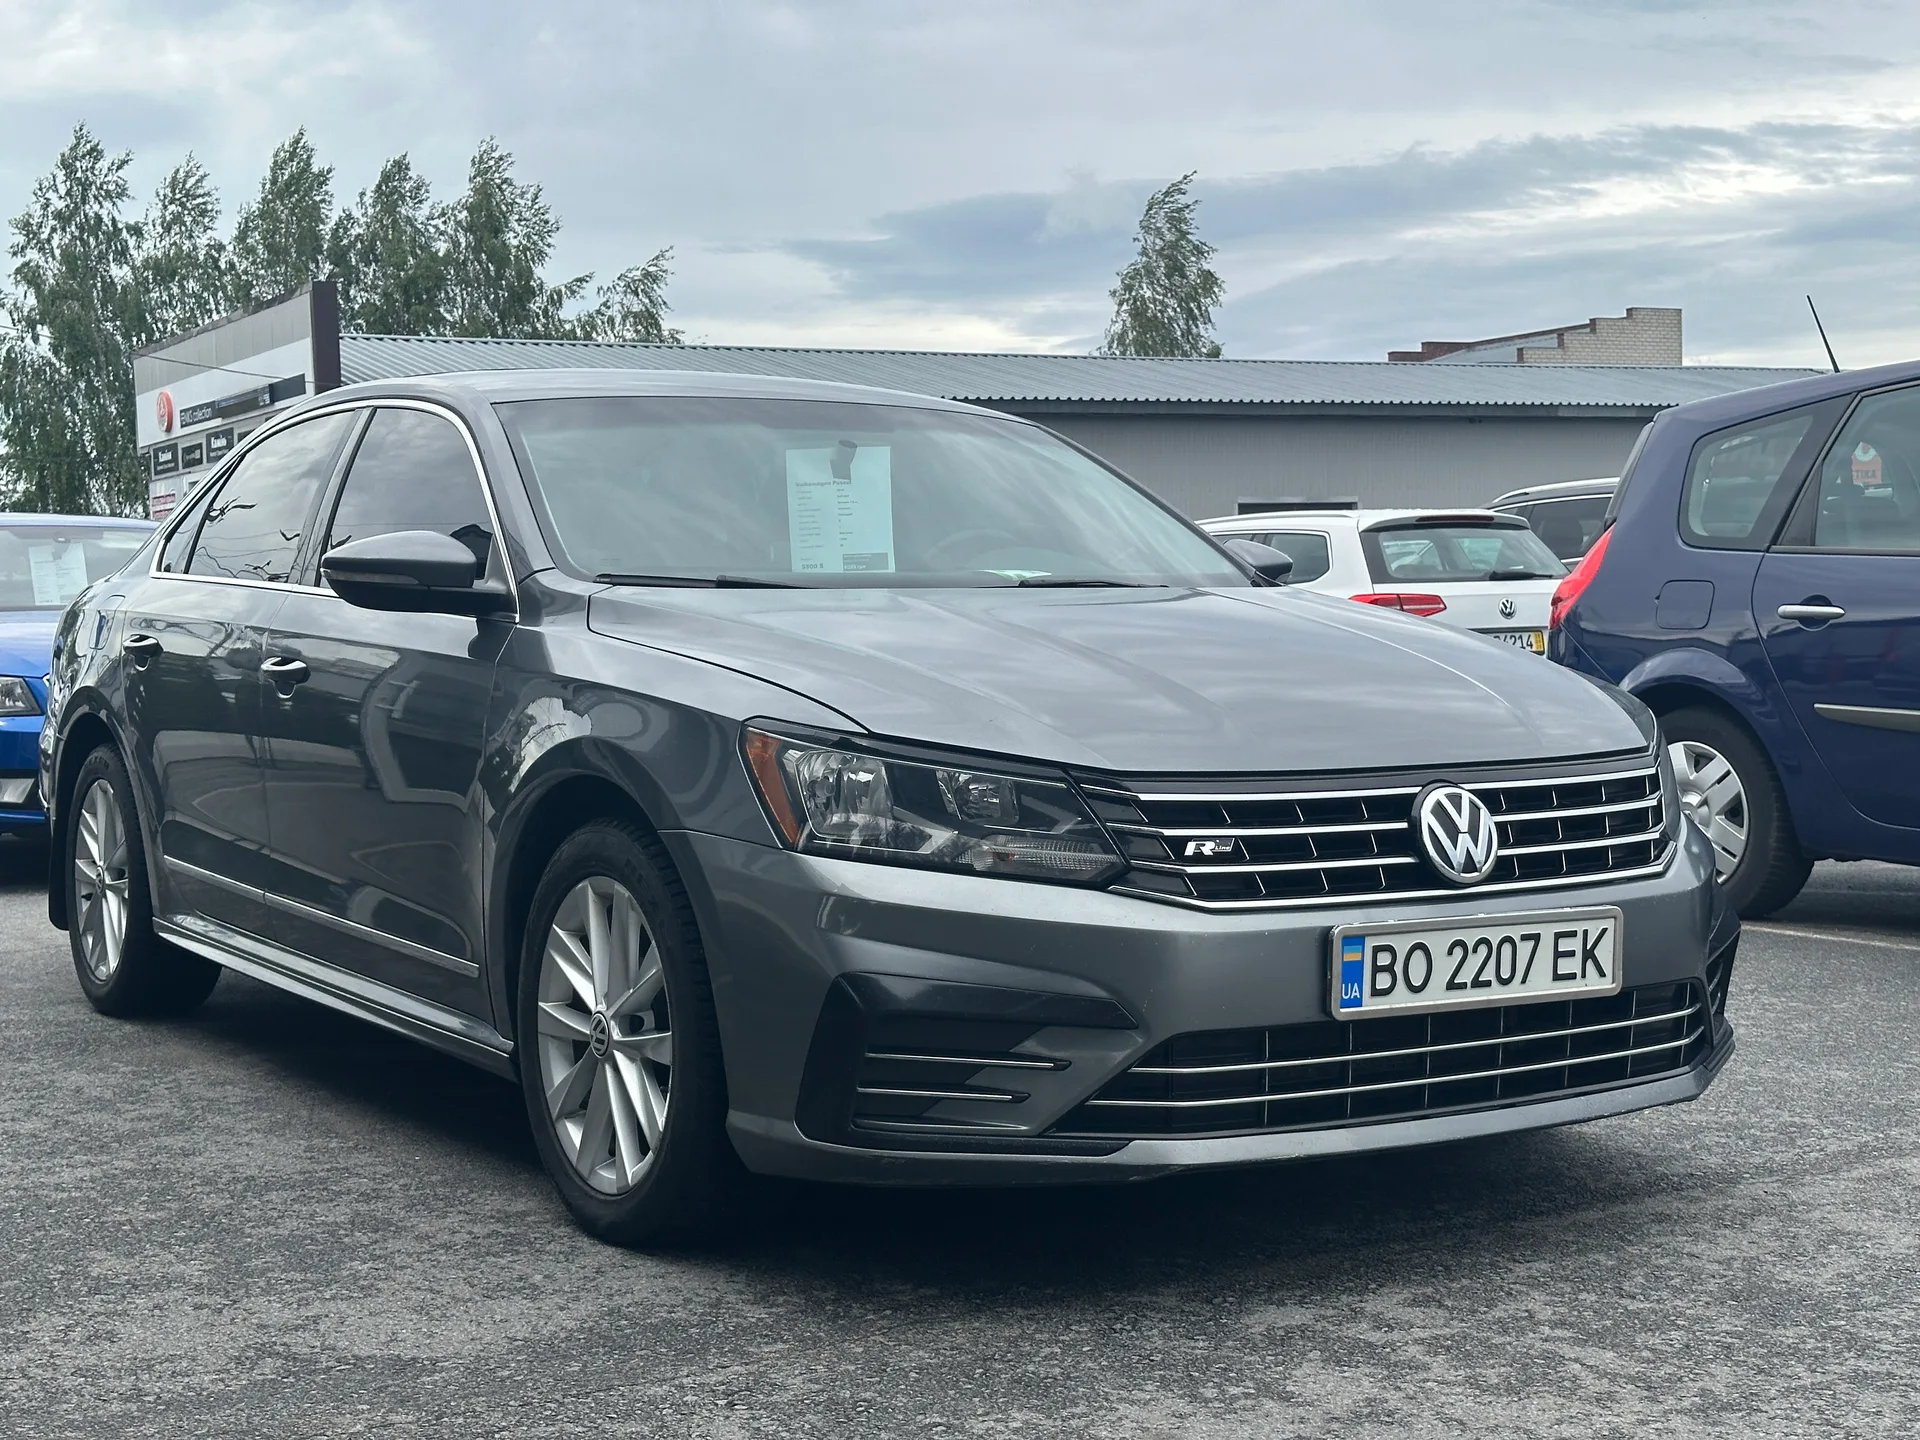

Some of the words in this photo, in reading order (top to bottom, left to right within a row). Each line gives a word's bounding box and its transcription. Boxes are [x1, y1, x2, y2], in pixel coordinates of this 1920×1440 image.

[1422, 786, 1497, 880] VW
[1341, 982, 1361, 1000] UA
[1370, 941, 1433, 997] BO
[1445, 932, 1541, 991] 2207
[1552, 926, 1609, 982] EK
